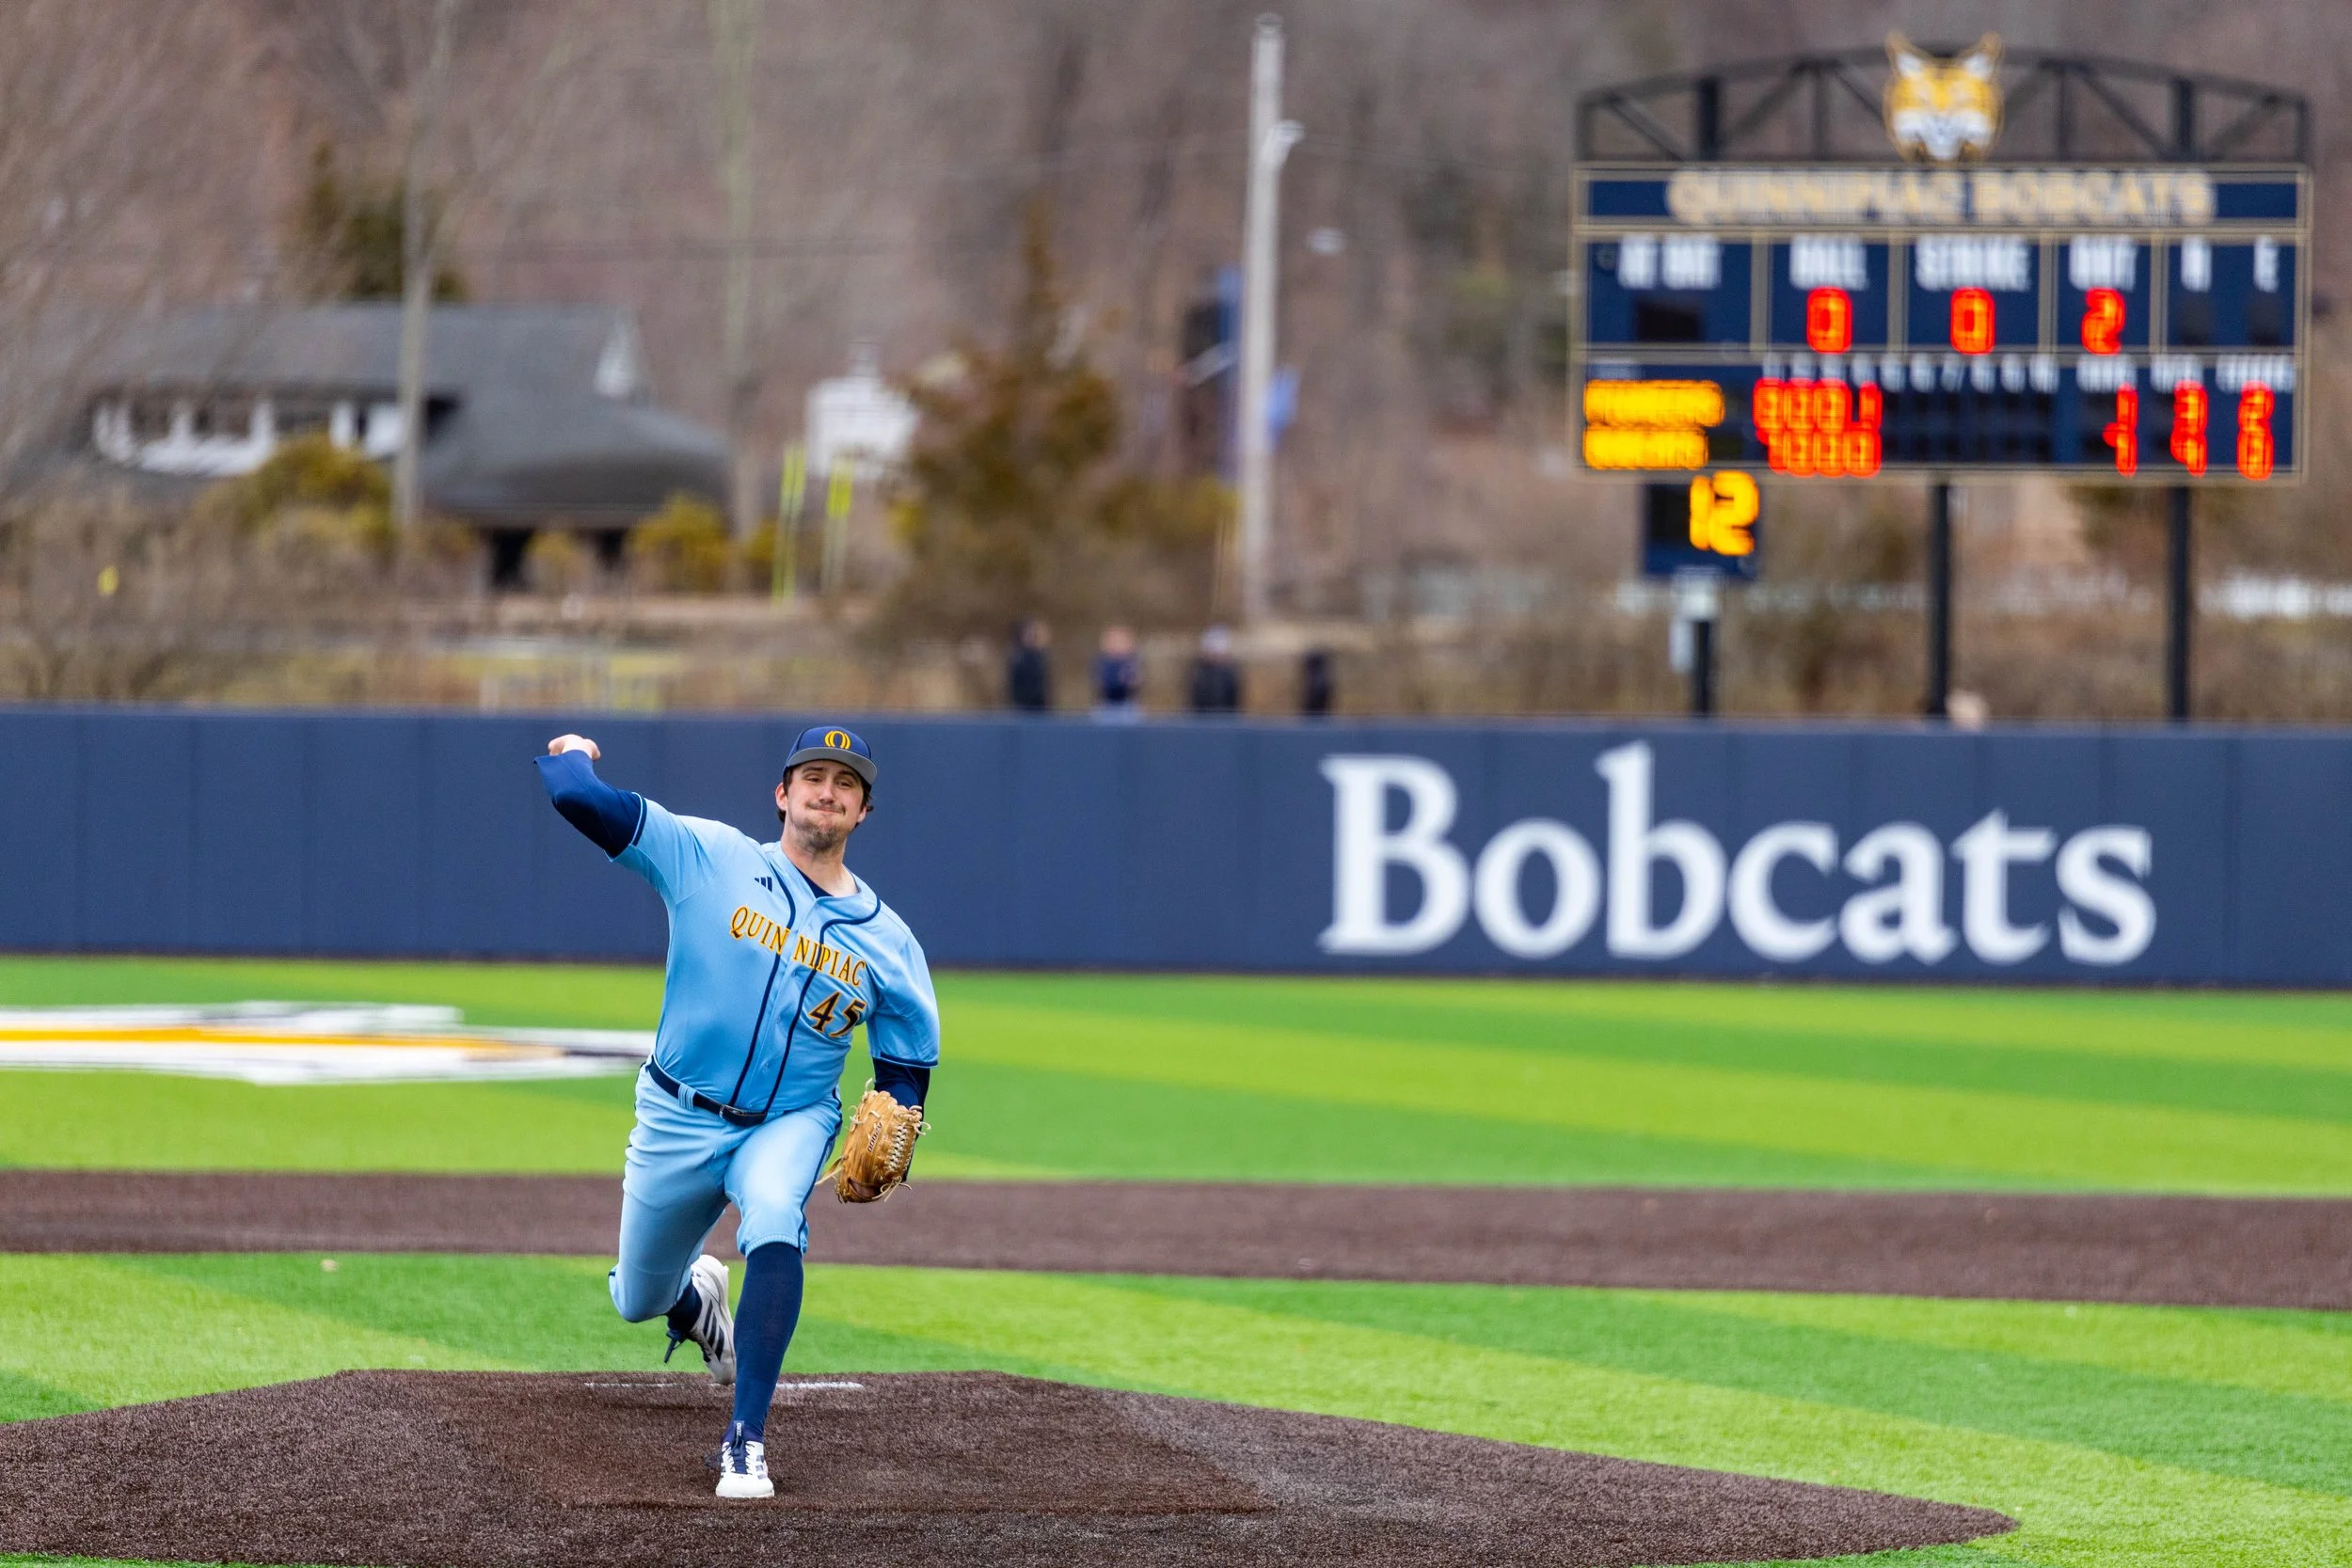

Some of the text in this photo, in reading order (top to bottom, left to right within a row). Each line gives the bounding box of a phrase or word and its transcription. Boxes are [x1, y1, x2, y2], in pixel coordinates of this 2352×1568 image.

[1915, 235, 2031, 292] STRIKE
[1806, 286, 1852, 354] 0
[1950, 287, 1995, 356] 0
[2081, 287, 2126, 356] 2
[1690, 470, 1760, 555] 12
[1319, 740, 2158, 964] Bobcats
[808, 990, 867, 1037] 45
